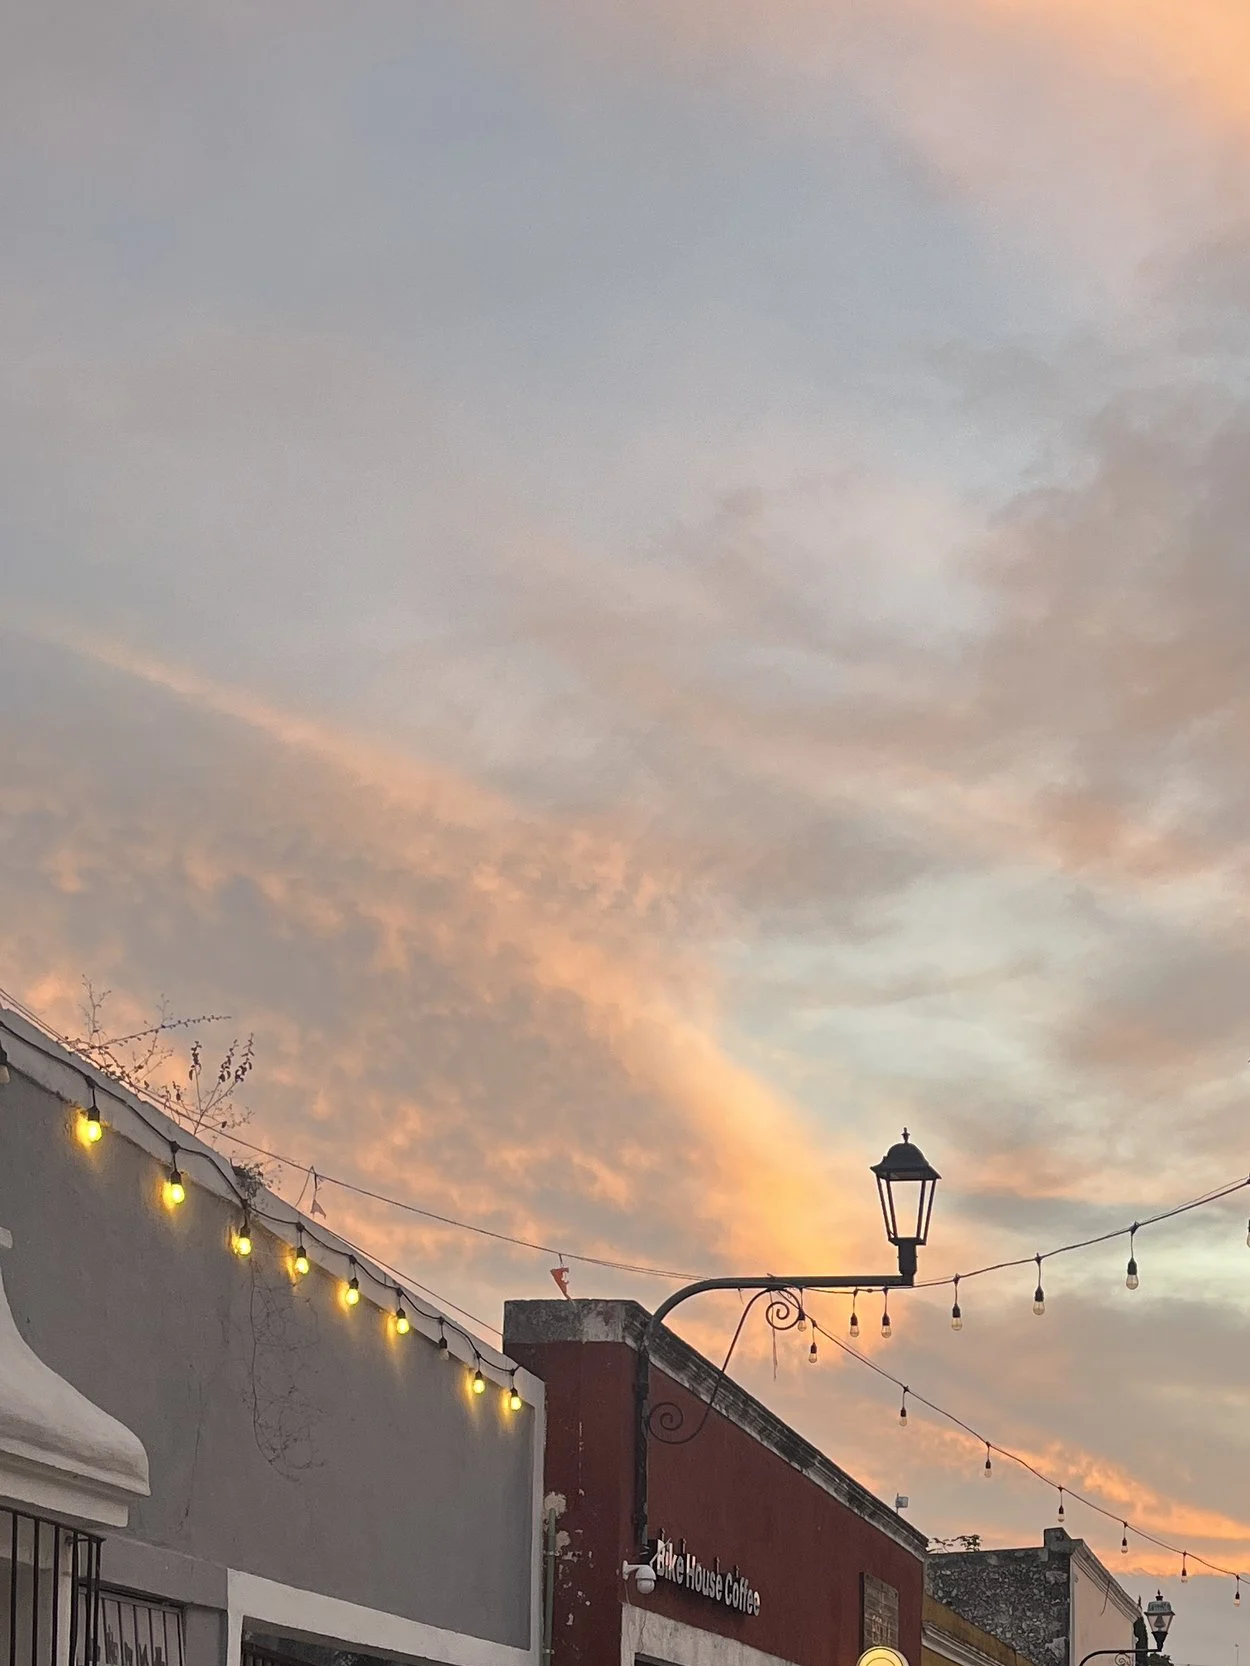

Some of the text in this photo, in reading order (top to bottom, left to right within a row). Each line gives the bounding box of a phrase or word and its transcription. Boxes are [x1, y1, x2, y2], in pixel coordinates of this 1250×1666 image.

[657, 1539, 761, 1617] Bike House Coffee
